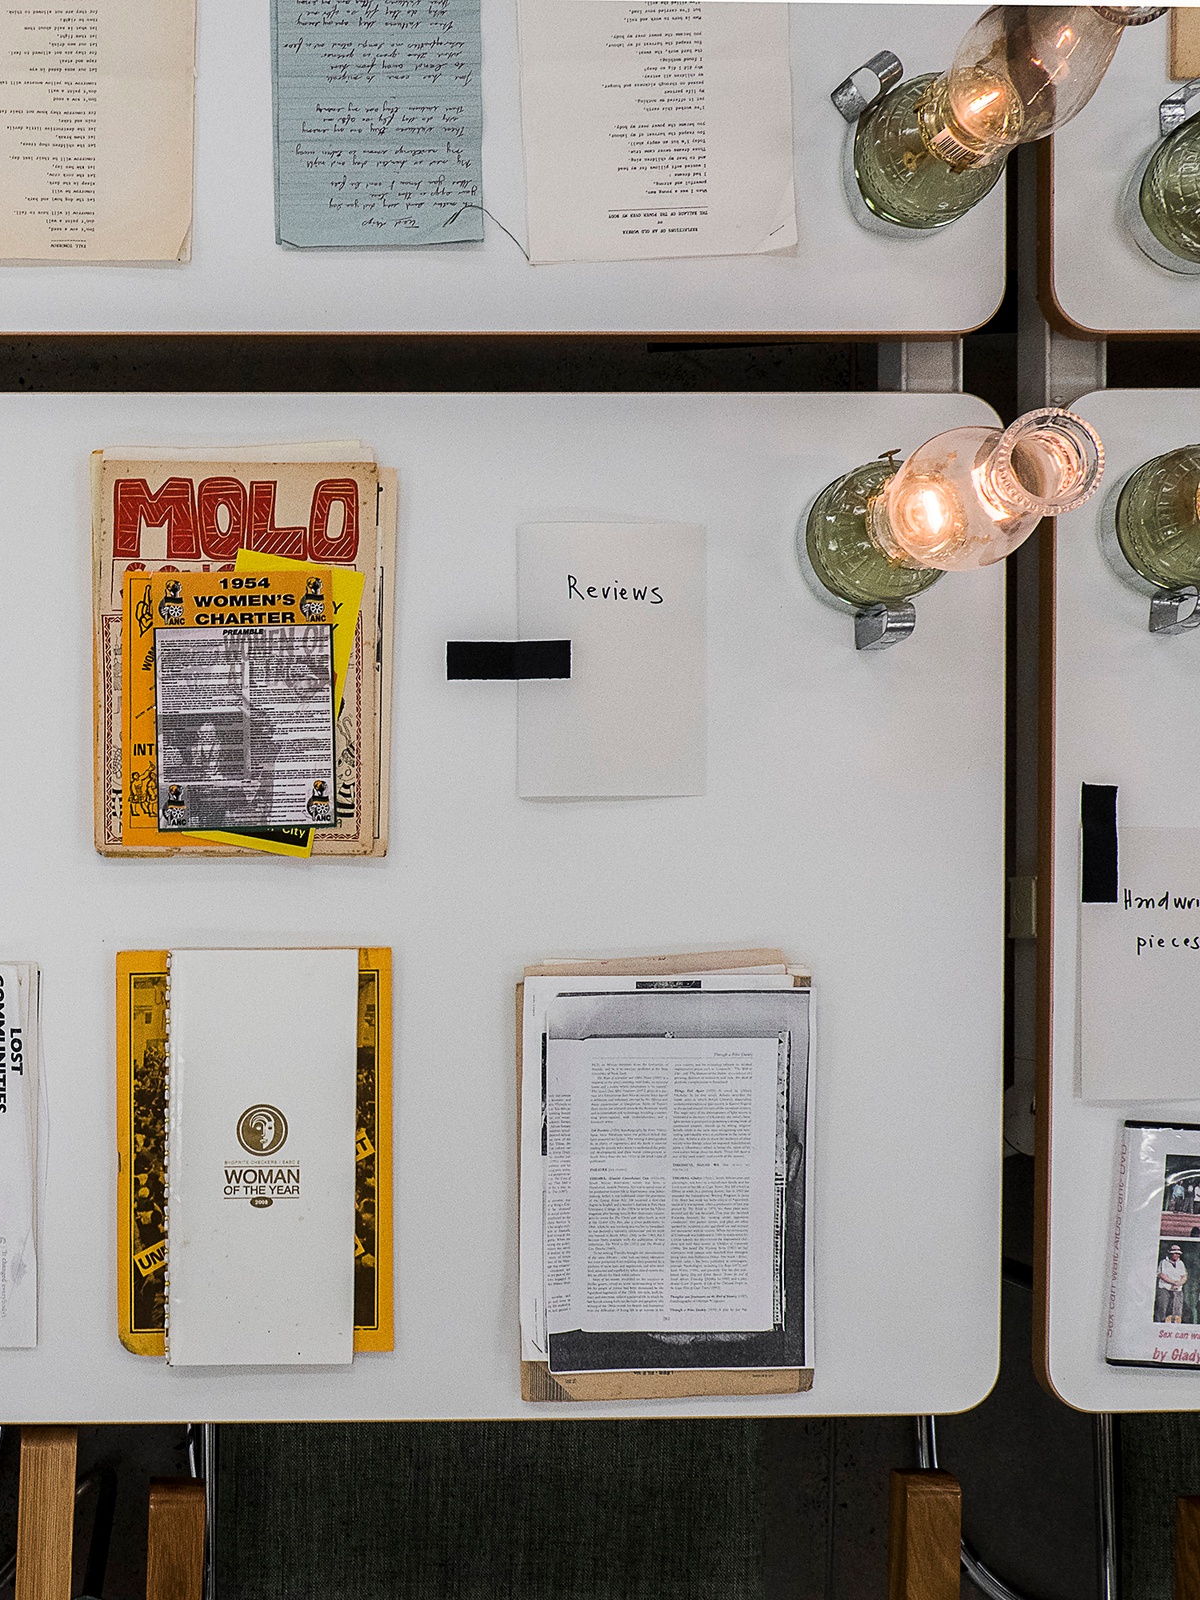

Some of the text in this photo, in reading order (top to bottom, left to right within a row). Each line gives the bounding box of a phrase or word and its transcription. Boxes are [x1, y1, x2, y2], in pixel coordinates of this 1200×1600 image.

[113, 477, 359, 562] MOLO
[219, 577, 271, 590] 1954
[567, 574, 664, 605] Reviews
[193, 594, 296, 608] WOMEN'S
[168, 617, 185, 625] ANC
[194, 613, 296, 625] CHARTER
[310, 614, 327, 622] ANC
[222, 628, 264, 636] PREAMBLE
[171, 818, 186, 827] ANC
[316, 814, 331, 823] ANC
[281, 826, 306, 839] City
[1136, 934, 1200, 956] pieces
[10, 1028, 23, 1076] LOST
[224, 1169, 300, 1184] WOMAN
[223, 1185, 300, 1195] OF THE YEAR
[1158, 1329, 1172, 1339] Sex
[1174, 1331, 1189, 1340] can
[1152, 1347, 1168, 1362] by
